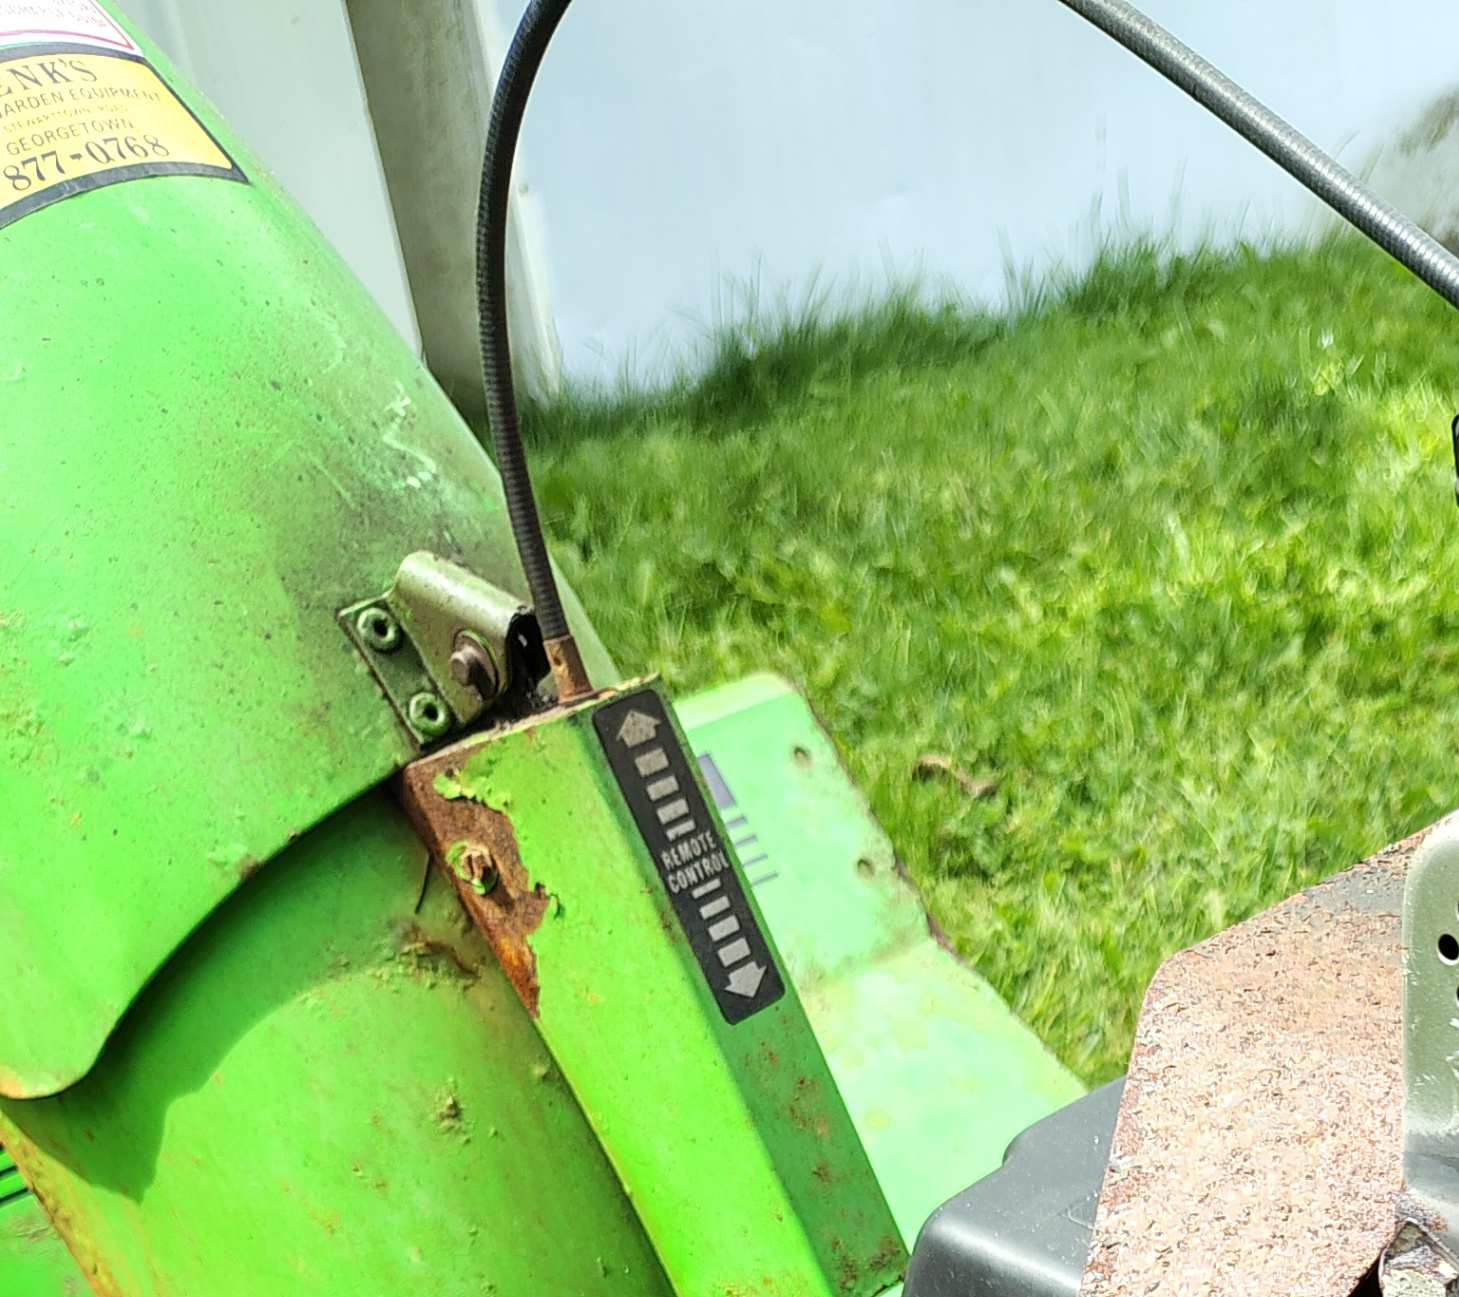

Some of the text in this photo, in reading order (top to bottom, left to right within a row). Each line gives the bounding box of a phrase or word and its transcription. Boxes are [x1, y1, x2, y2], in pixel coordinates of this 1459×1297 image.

[0, 87, 162, 119] ARDEN EQUIPMENT
[6, 117, 135, 156] GEORGETOWN
[2, 134, 170, 192] 877-0768
[661, 831, 717, 872] REMOTE
[668, 848, 730, 894] CONTROL
